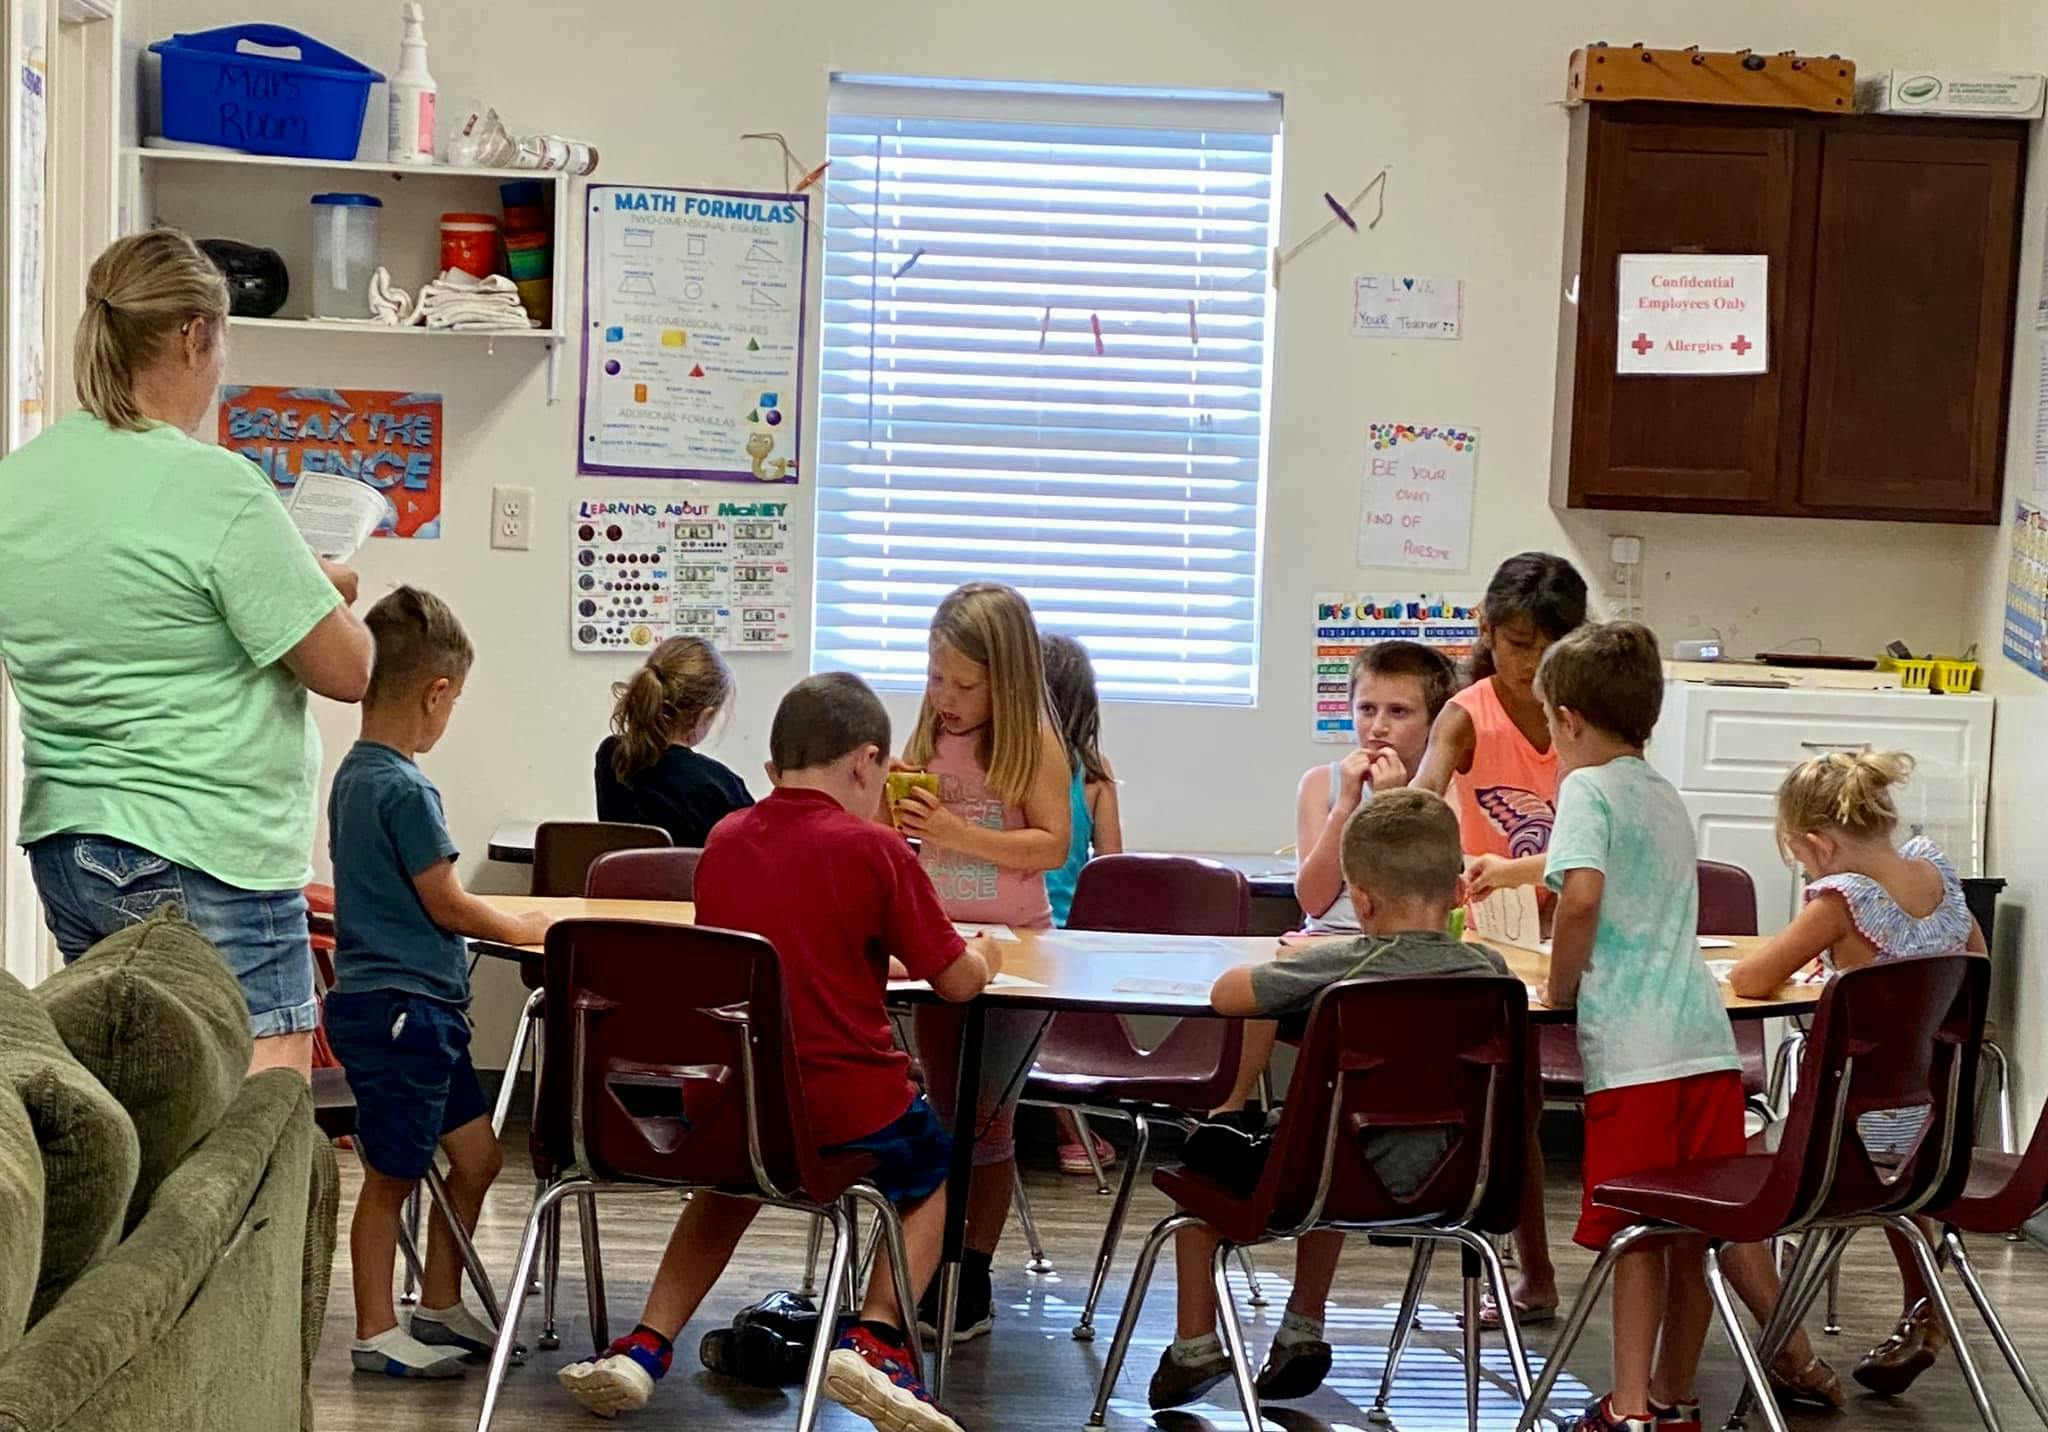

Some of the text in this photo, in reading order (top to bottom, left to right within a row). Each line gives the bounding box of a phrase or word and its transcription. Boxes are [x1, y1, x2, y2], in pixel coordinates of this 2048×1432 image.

[220, 101, 308, 145] Room
[614, 193, 796, 224] MATH FORMULAS
[1359, 276, 1378, 289] I
[1651, 275, 1734, 289] Confidential
[1638, 296, 1746, 312] Employees Only
[1664, 339, 1723, 353] Allergies
[229, 407, 433, 447] BREAK THE
[1371, 458, 1399, 476] BE
[579, 501, 788, 518] LEARNING ABOUT MONEY
[1401, 515, 1423, 528] OF
